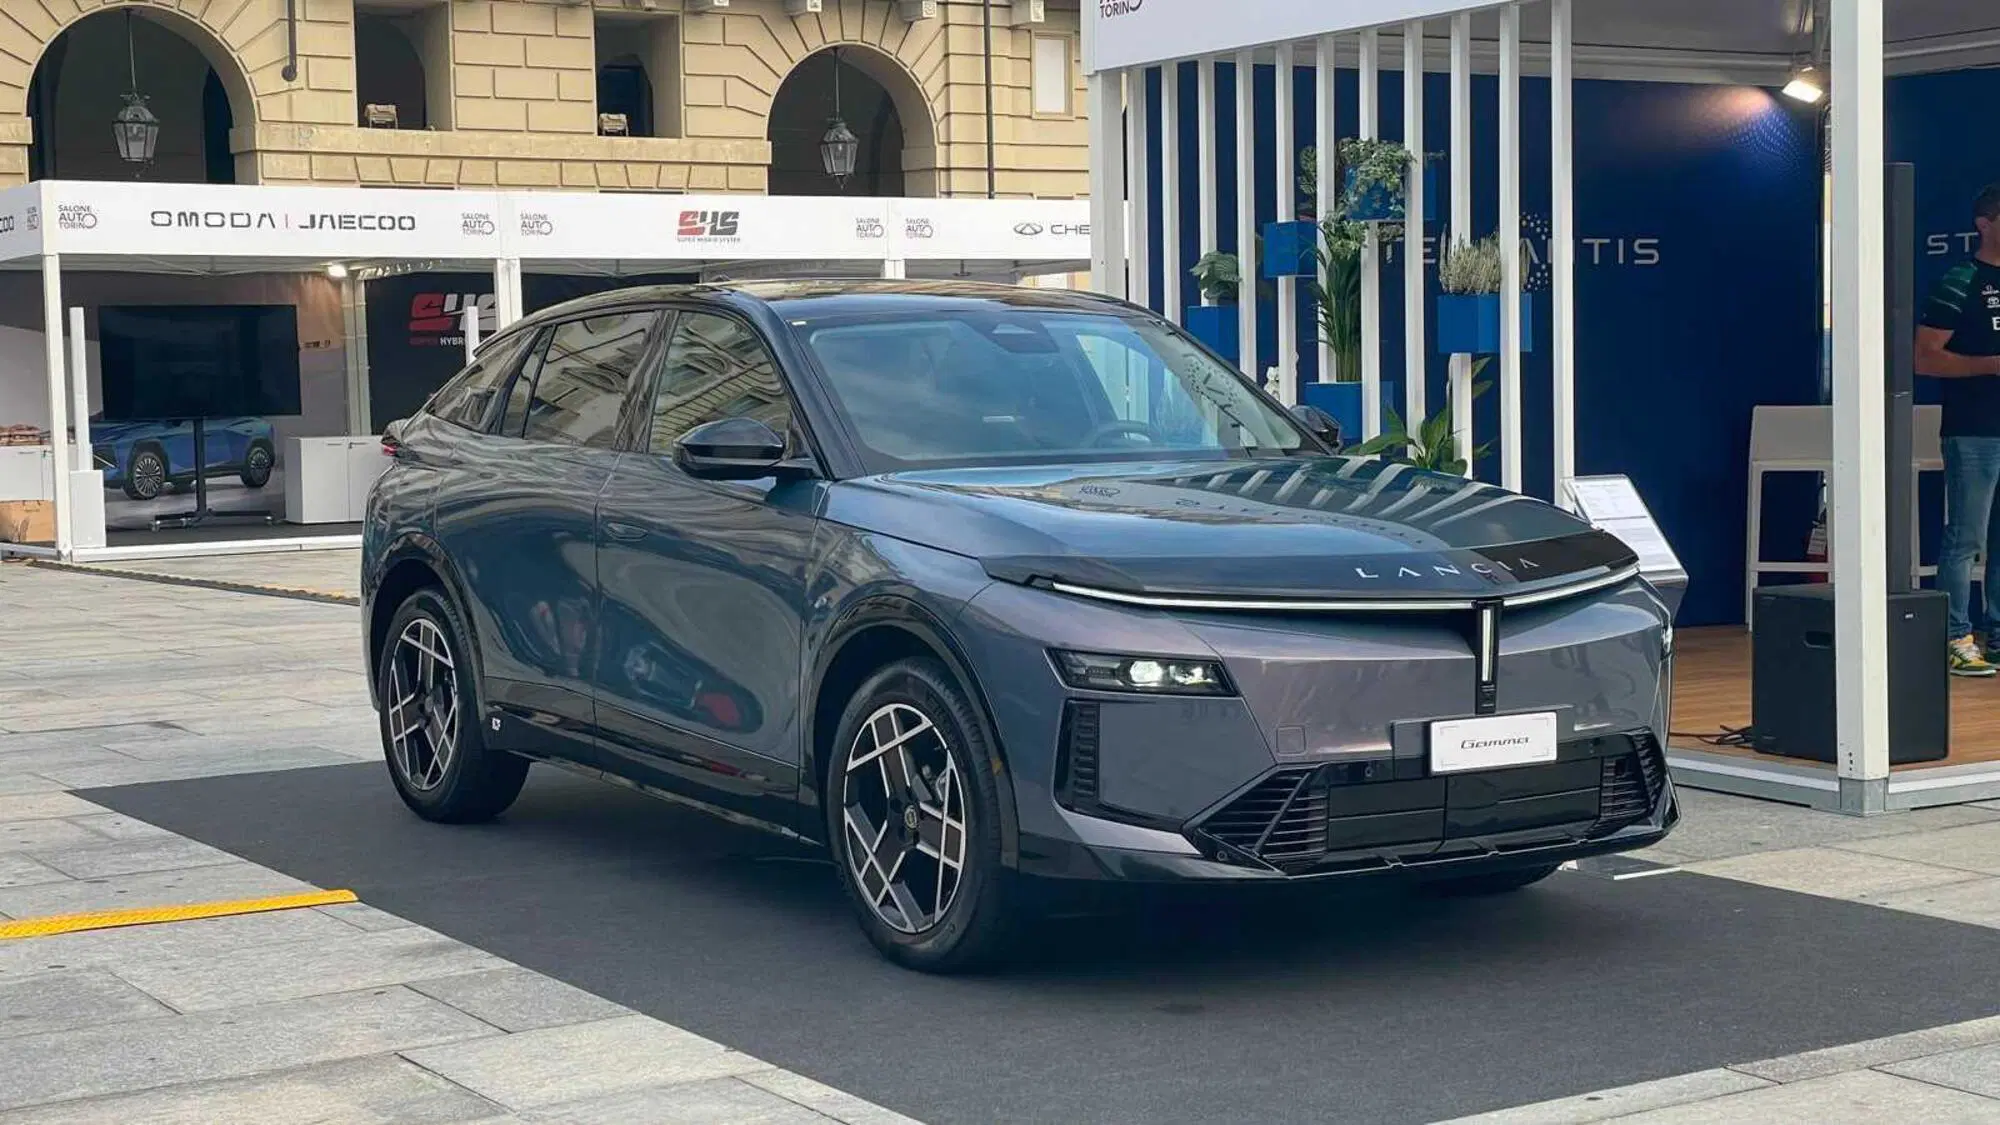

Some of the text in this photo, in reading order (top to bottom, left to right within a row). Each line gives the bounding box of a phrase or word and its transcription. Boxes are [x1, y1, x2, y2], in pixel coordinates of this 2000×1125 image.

[60, 213, 97, 228] AUTO
[150, 210, 416, 231] OMODA JAECOO
[463, 220, 495, 234] AUTO
[521, 220, 553, 234] AUTO
[440, 336, 466, 346] HYBR
[1355, 557, 1540, 578] LANCIA
[1460, 736, 1530, 750] Gamma
